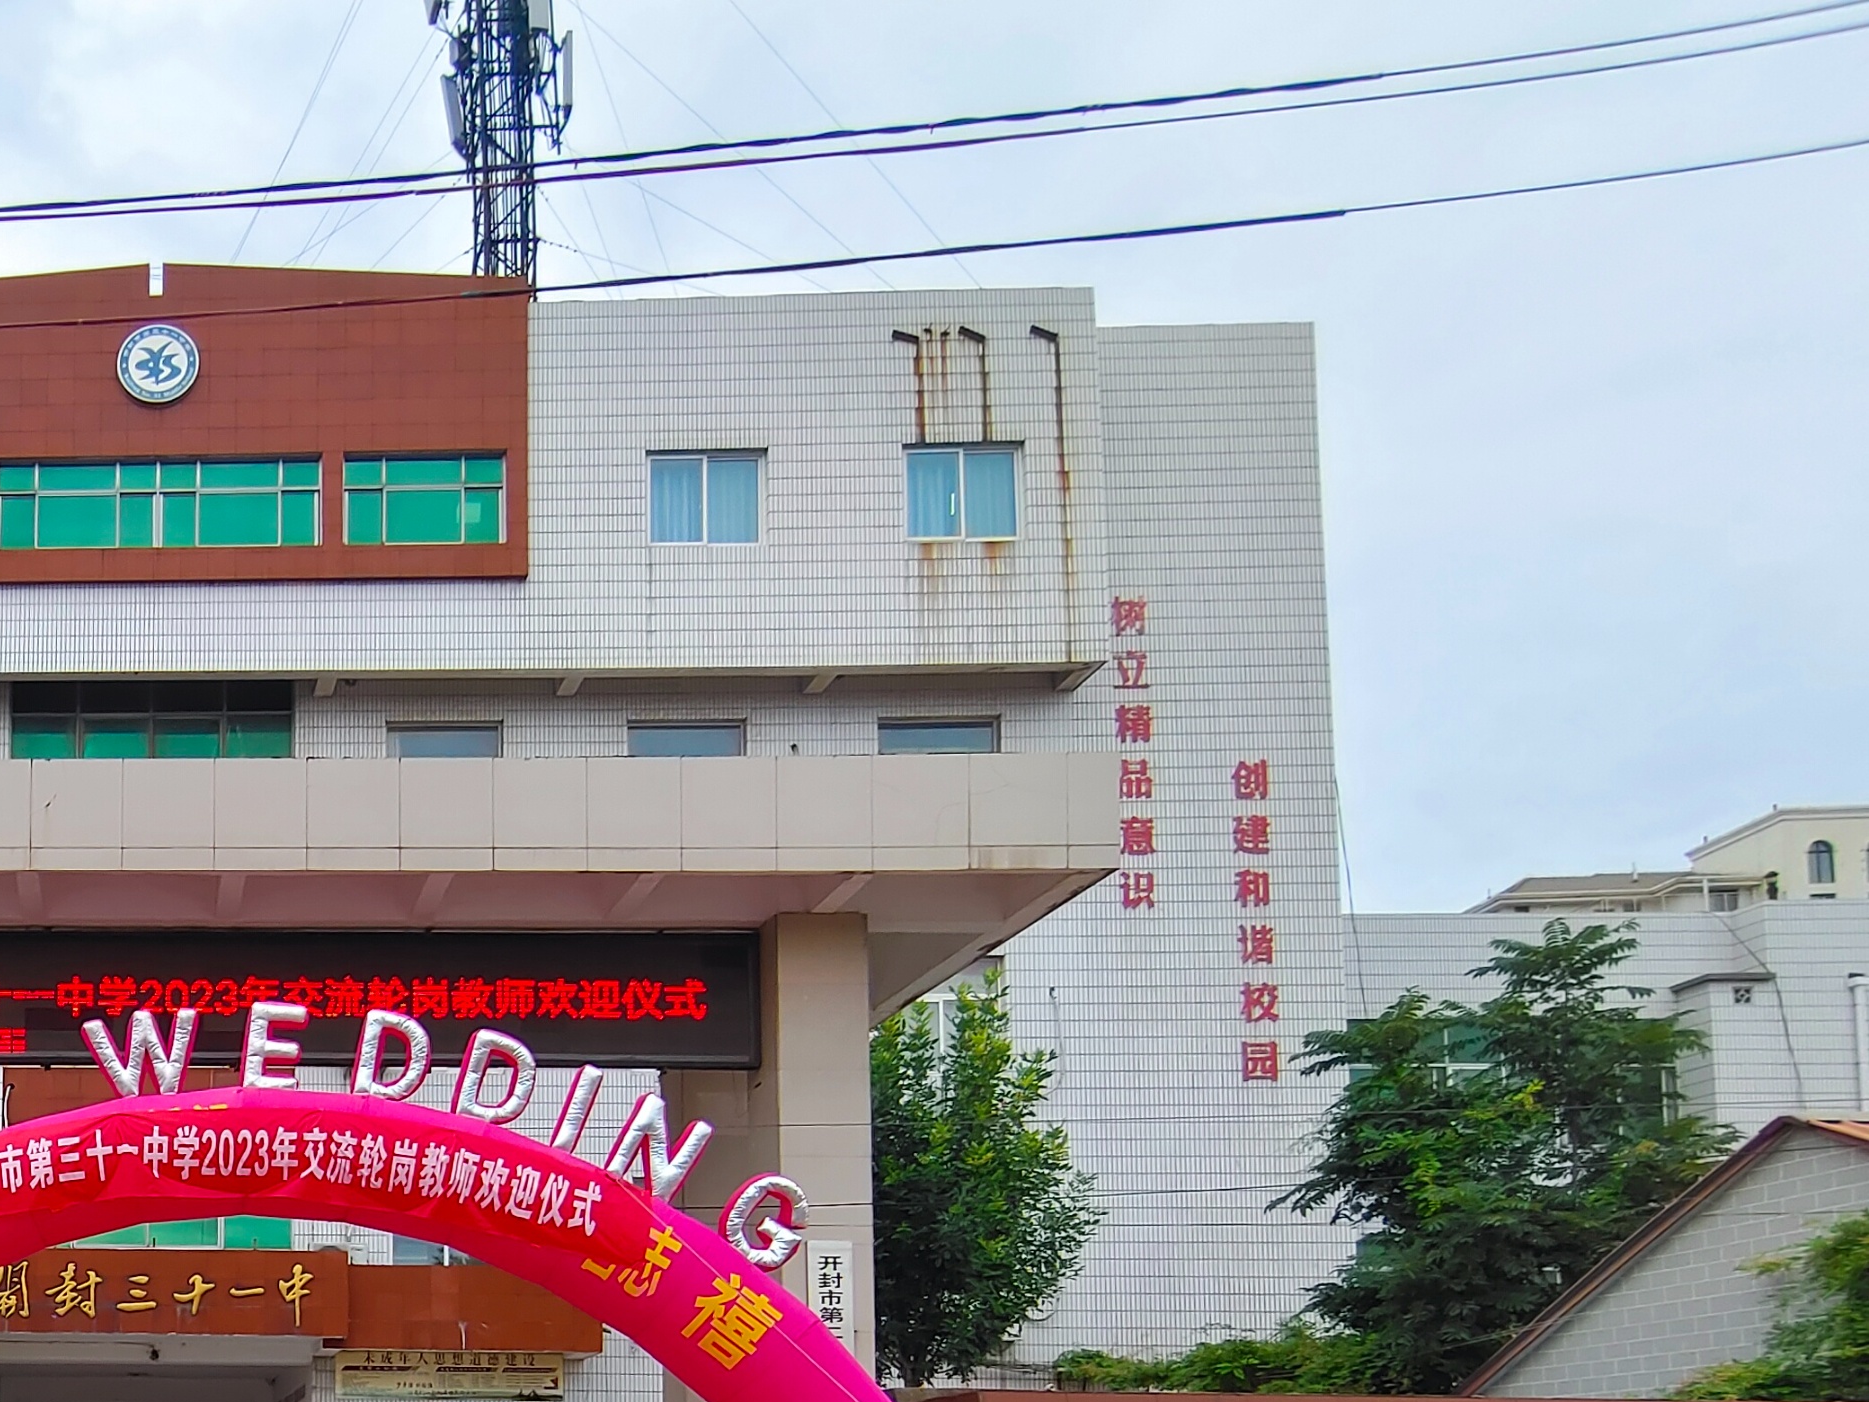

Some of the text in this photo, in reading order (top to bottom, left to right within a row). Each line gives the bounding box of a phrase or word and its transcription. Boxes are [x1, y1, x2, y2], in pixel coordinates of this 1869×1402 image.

[1110, 595, 1156, 910] 树立精品意识
[1231, 760, 1280, 1082] 创建和谐校园
[81, 1001, 810, 1269] WEDDING
[581, 1225, 784, 1371] 志禧
